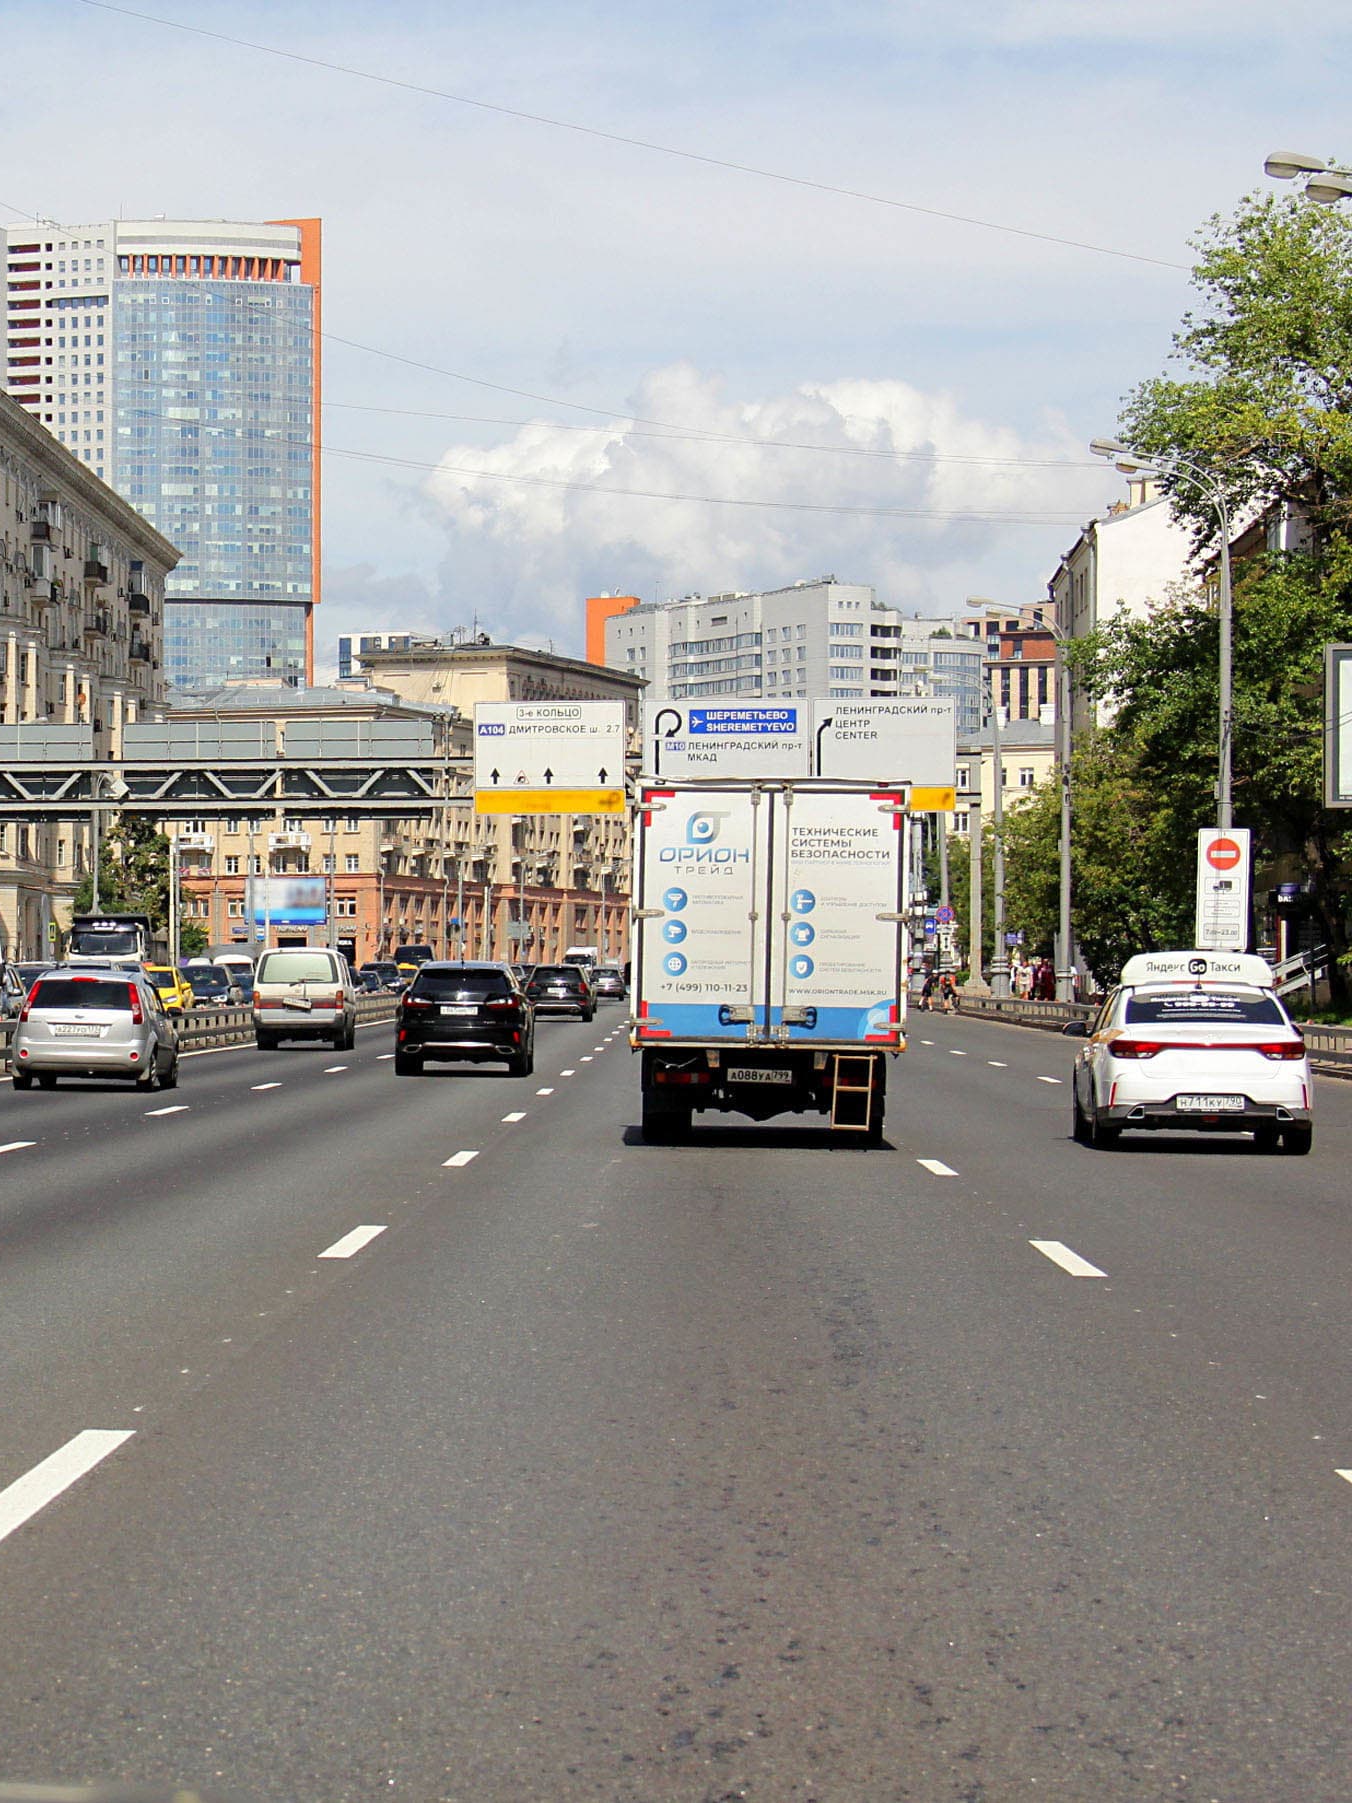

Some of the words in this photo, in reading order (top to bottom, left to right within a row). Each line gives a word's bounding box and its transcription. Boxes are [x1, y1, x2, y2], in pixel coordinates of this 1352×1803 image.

[536, 707, 580, 718] КОЛЬЦО
[835, 704, 928, 715] ЛЕНИНГРАДСКИЙ
[706, 711, 789, 721] ШЕРЕМЕТЬЕВО
[706, 722, 795, 732] SHEREMET'YEVO
[835, 719, 871, 729] ЦЕНТР
[479, 725, 505, 735] А104
[508, 724, 587, 735] ДМИТРОВСКОЕ
[835, 731, 878, 740] CENTER
[687, 740, 779, 751] ЛЕНИНГРАДСКИЙ
[687, 753, 717, 762] МКАД
[791, 827, 879, 837] ТЕХНИЧЕСКИЕ
[791, 838, 852, 848] СИСТЕМЫ
[659, 847, 750, 863] ОРИОН
[791, 849, 891, 859] БЕЗОПАСНОСТИ
[673, 864, 734, 875] ТРЕЙД
[1146, 961, 1186, 973] Яндекс
[1189, 962, 1206, 973] Go
[1209, 961, 1241, 972] Такси
[660, 983, 673, 991] +7
[675, 983, 702, 993] (499)
[705, 983, 748, 993] 110-11-23
